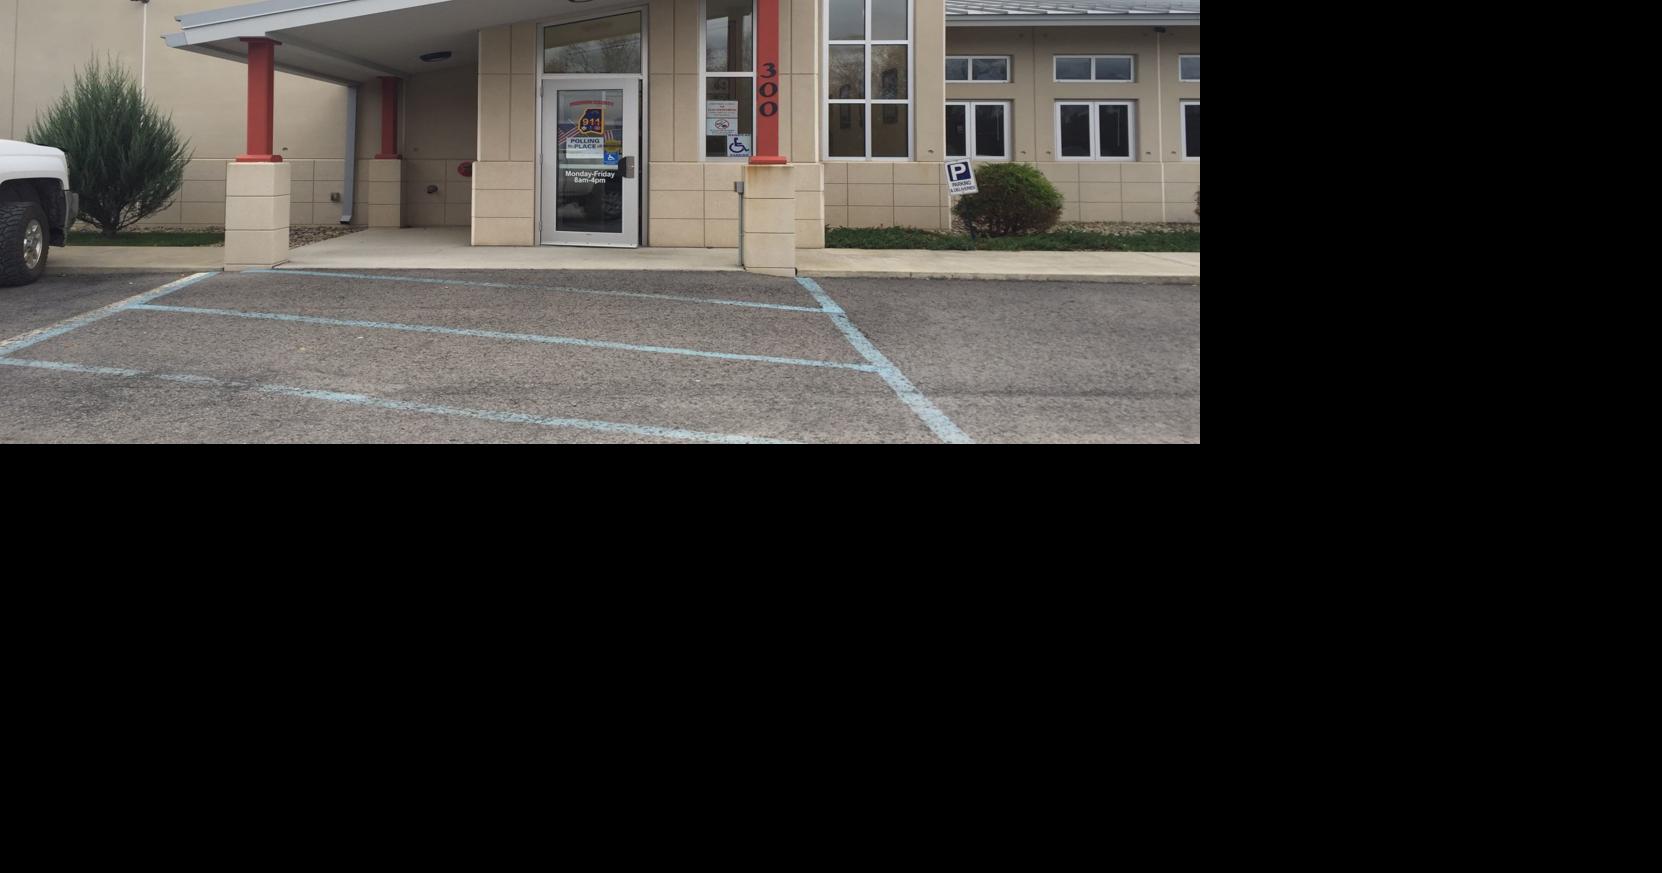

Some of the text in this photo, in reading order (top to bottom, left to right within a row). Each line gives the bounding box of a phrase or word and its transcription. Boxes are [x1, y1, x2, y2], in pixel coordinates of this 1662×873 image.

[759, 62, 778, 117] 300
[582, 118, 601, 126] 911
[565, 170, 615, 178] Monday-Friday
[950, 163, 967, 181] P
